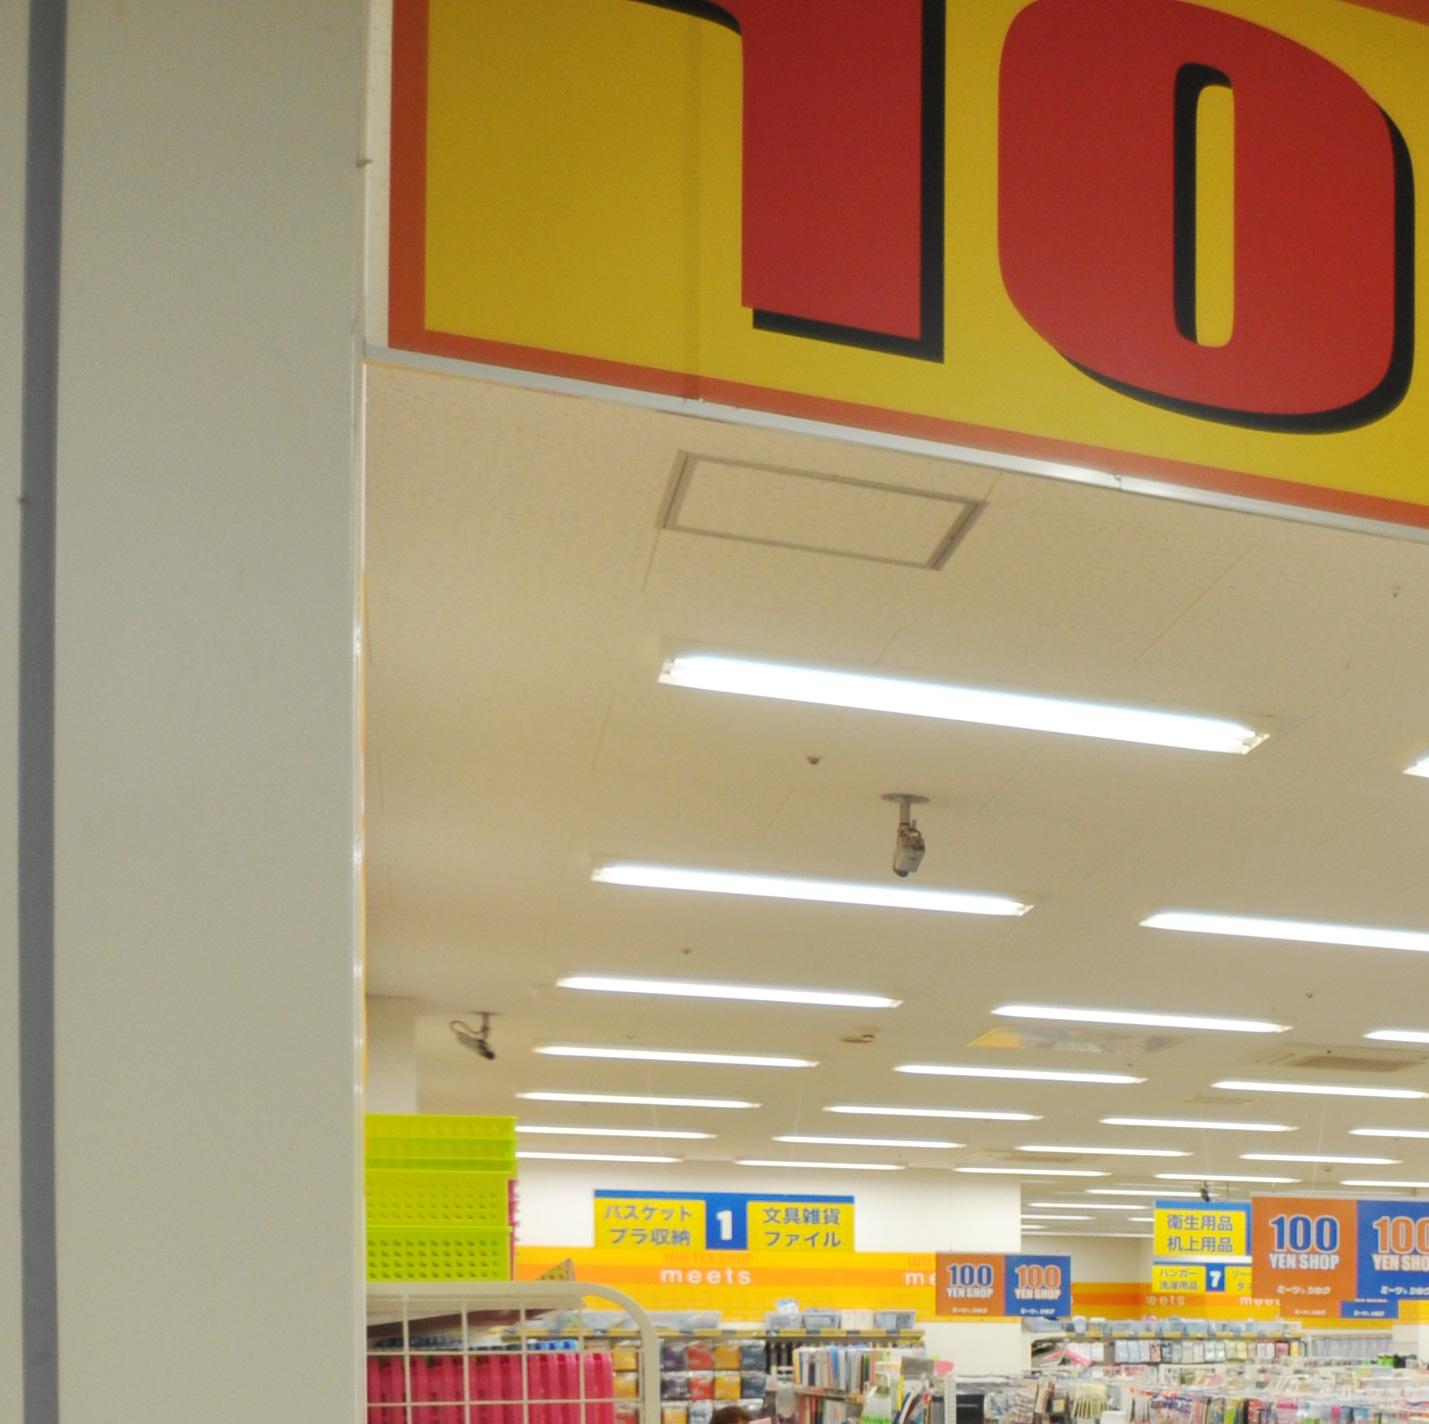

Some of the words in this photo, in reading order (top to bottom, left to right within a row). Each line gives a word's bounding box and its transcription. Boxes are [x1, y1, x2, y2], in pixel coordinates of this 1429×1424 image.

[604, 1205, 692, 1222] バスケット
[763, 1207, 841, 1225] 文具雑貨
[716, 1210, 733, 1241] 1
[1167, 1214, 1233, 1232] 衛生用品
[609, 1228, 691, 1246] プラ収納
[764, 1231, 842, 1248] ファイル
[1268, 1214, 1340, 1254] 100
[1269, 1253, 1297, 1270] YEN
[1298, 1253, 1340, 1271] SHOP
[1372, 1254, 1400, 1272] YEN
[660, 1267, 753, 1285] meets
[946, 1263, 994, 1287] 100
[1014, 1264, 1062, 1289] 100
[1209, 1271, 1222, 1288] 7
